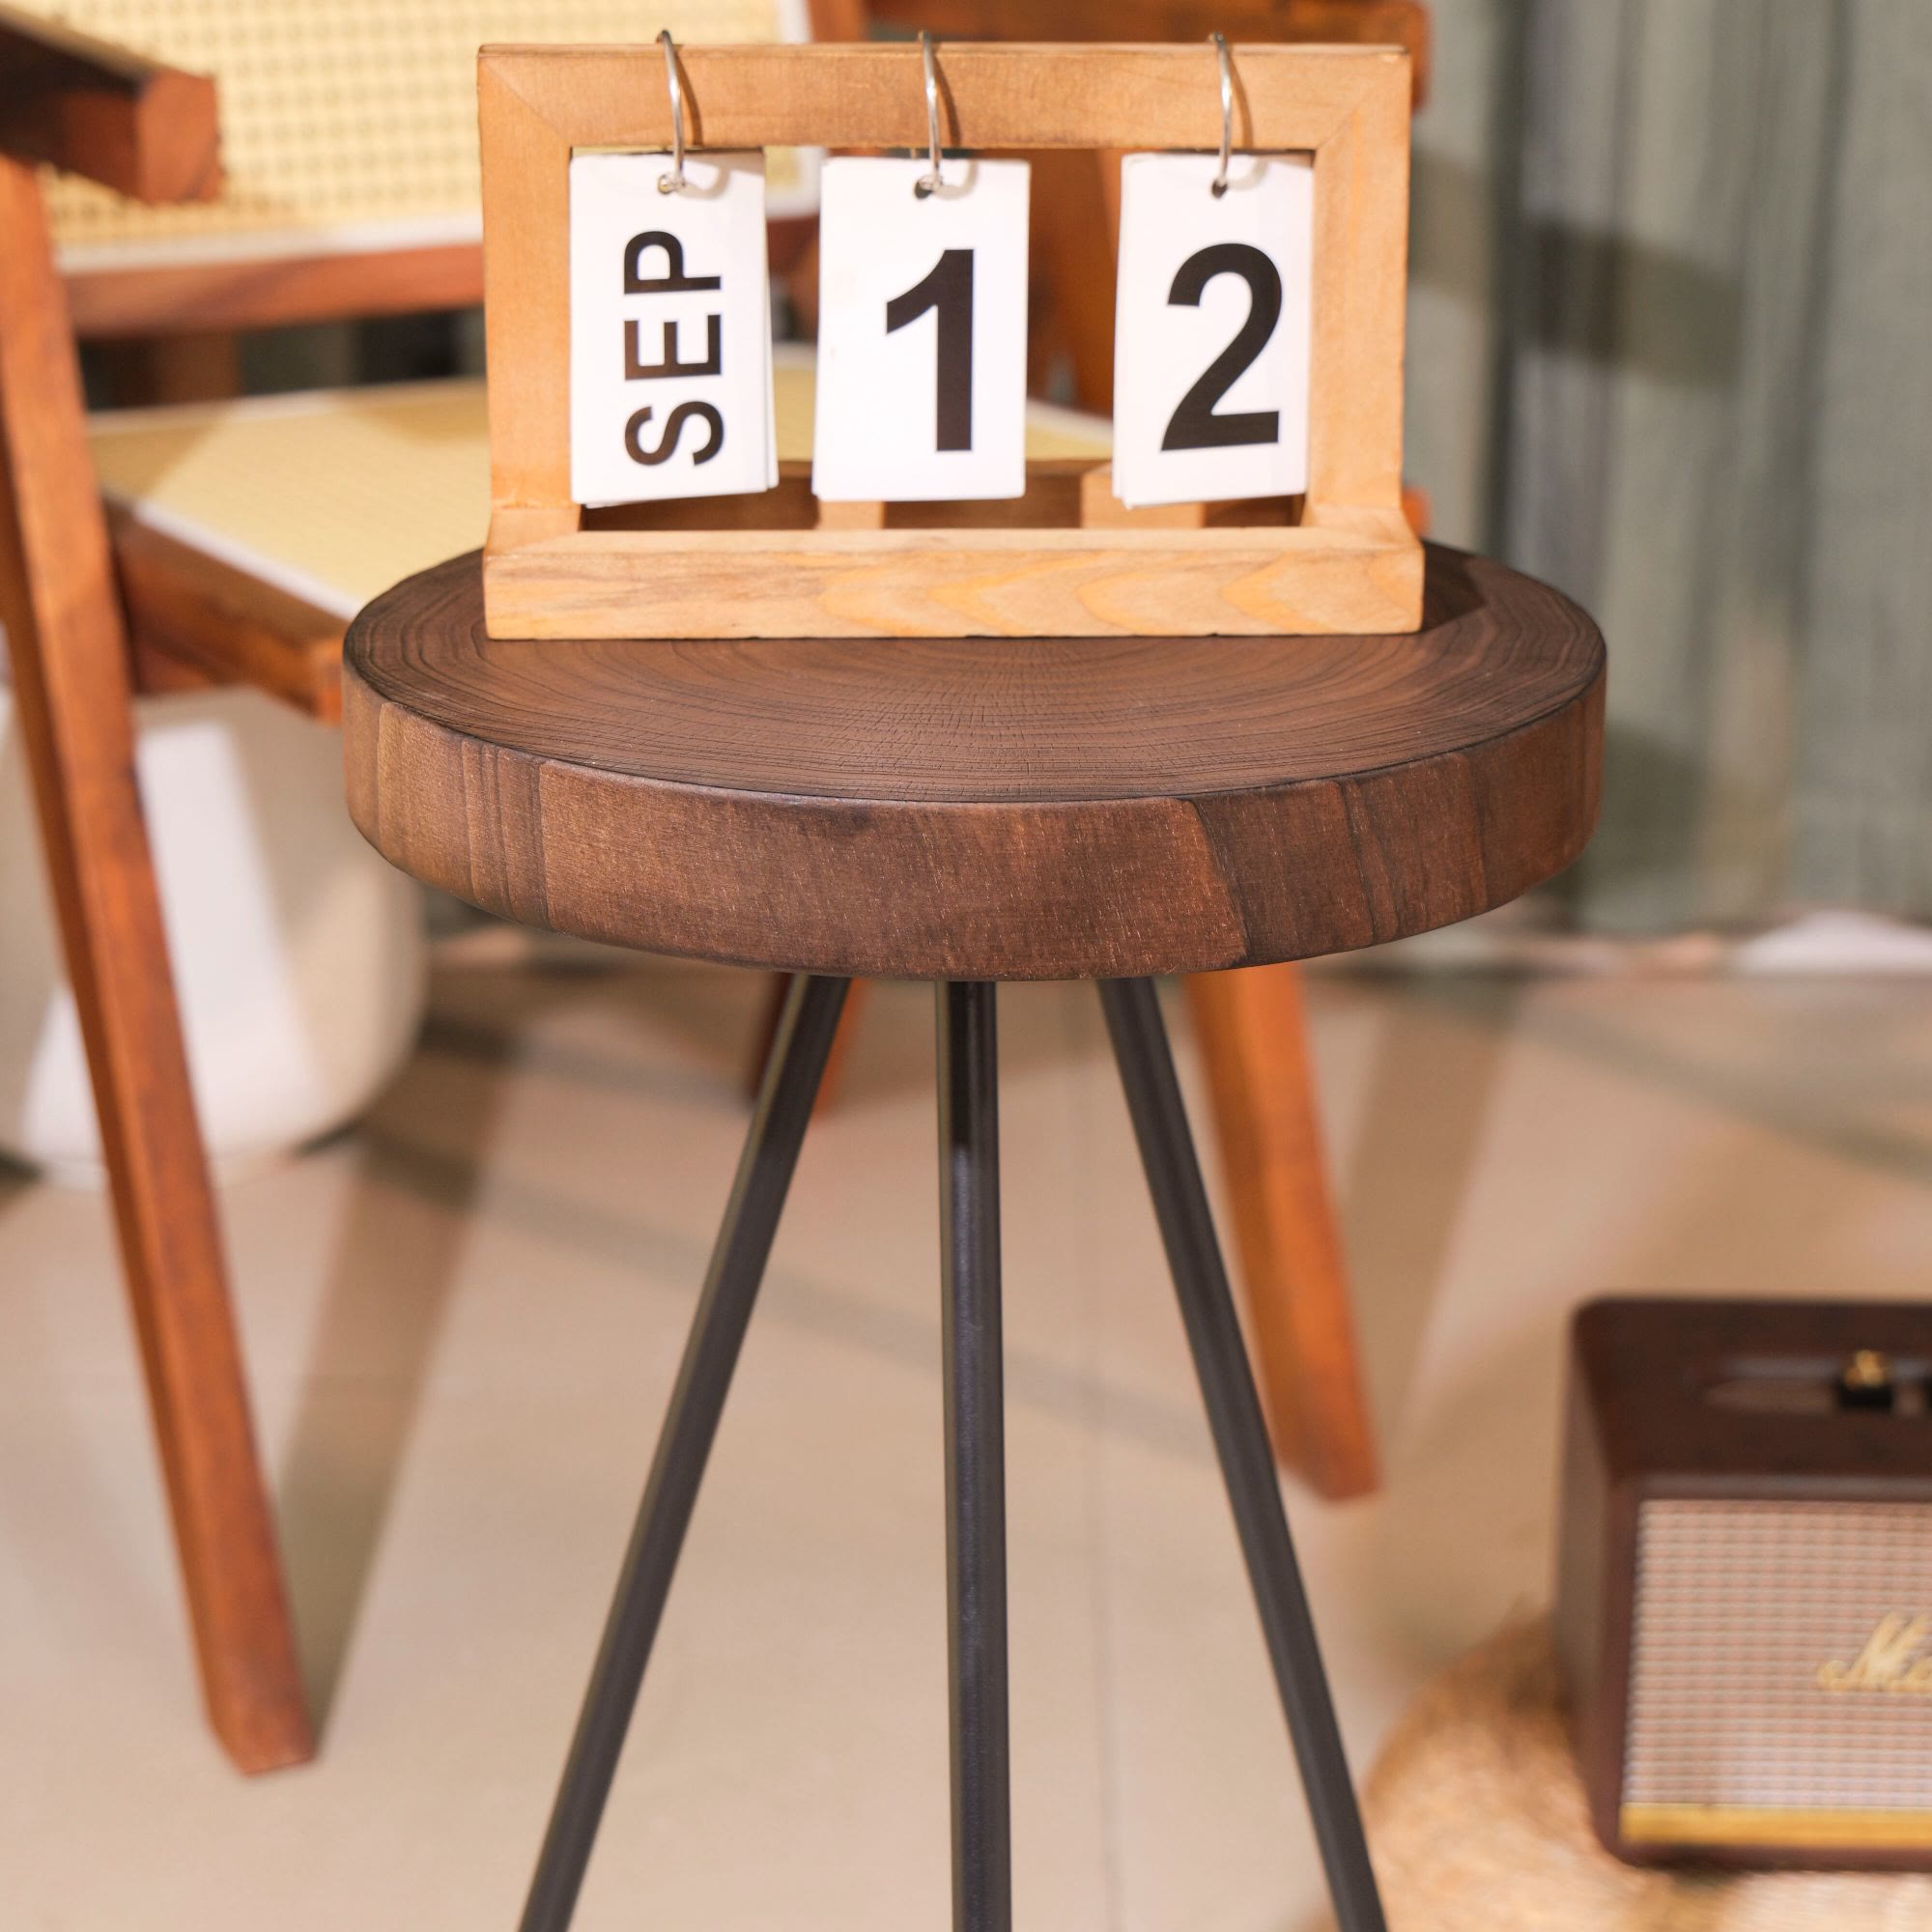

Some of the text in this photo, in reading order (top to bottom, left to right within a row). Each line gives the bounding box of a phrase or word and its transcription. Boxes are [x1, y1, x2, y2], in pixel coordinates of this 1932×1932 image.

[623, 230, 724, 467] SEP
[886, 248, 975, 451] 1
[1161, 242, 1284, 452] 2
